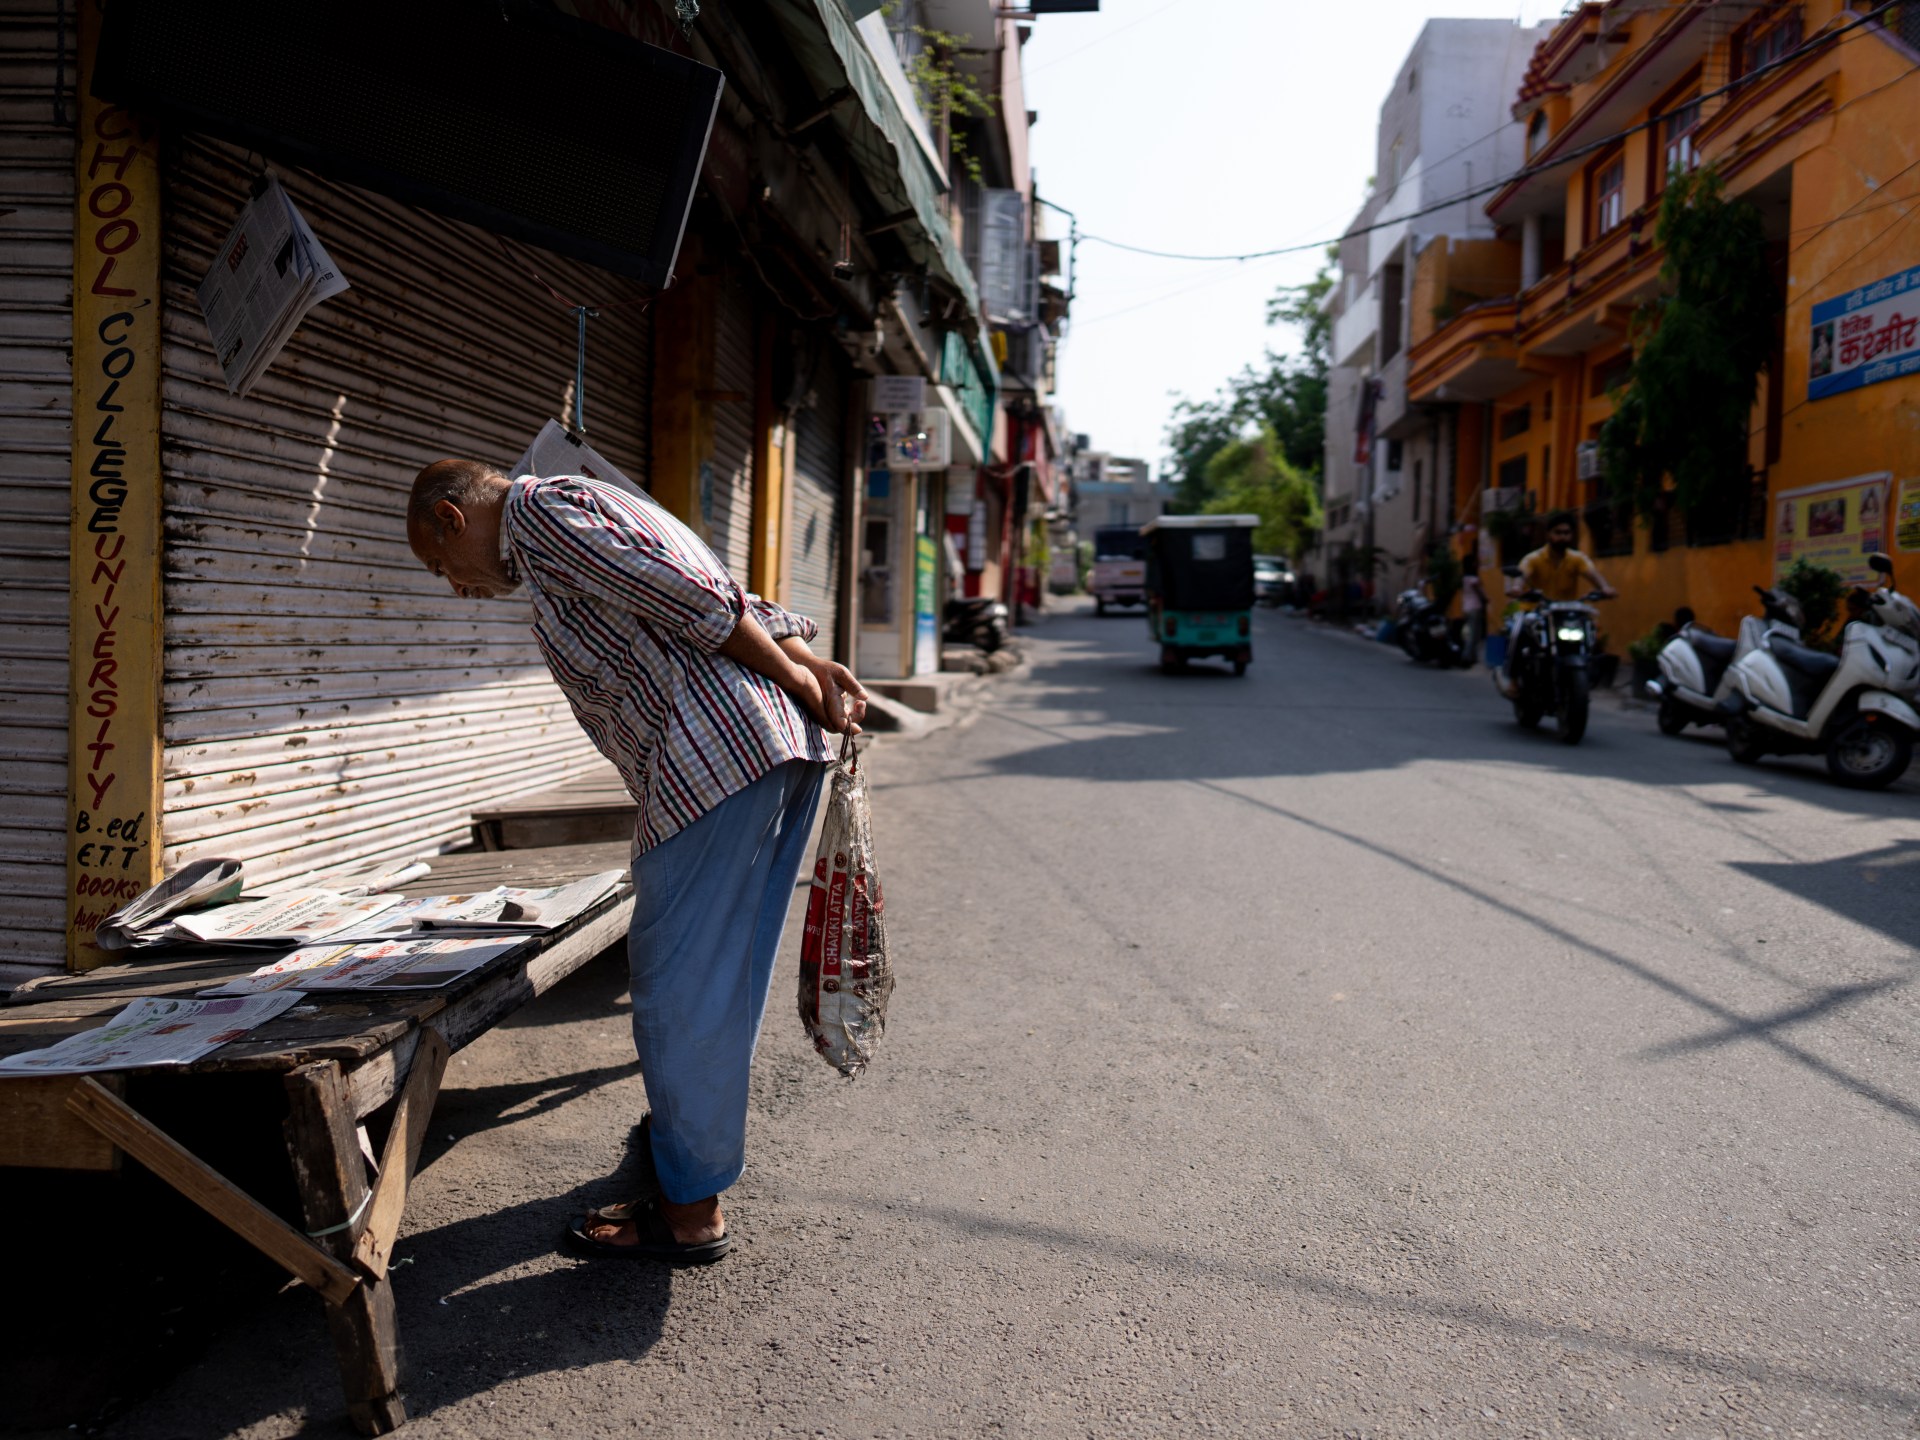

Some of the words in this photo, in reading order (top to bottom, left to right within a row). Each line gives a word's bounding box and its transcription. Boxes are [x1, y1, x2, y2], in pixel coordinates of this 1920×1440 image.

[88, 105, 151, 309] CHOOL,
[88, 312, 135, 532] COLLEGE
[87, 533, 126, 810] UNIVERSITY
[76, 873, 140, 900] BOOKS
[830, 882, 843, 914] ATTA
